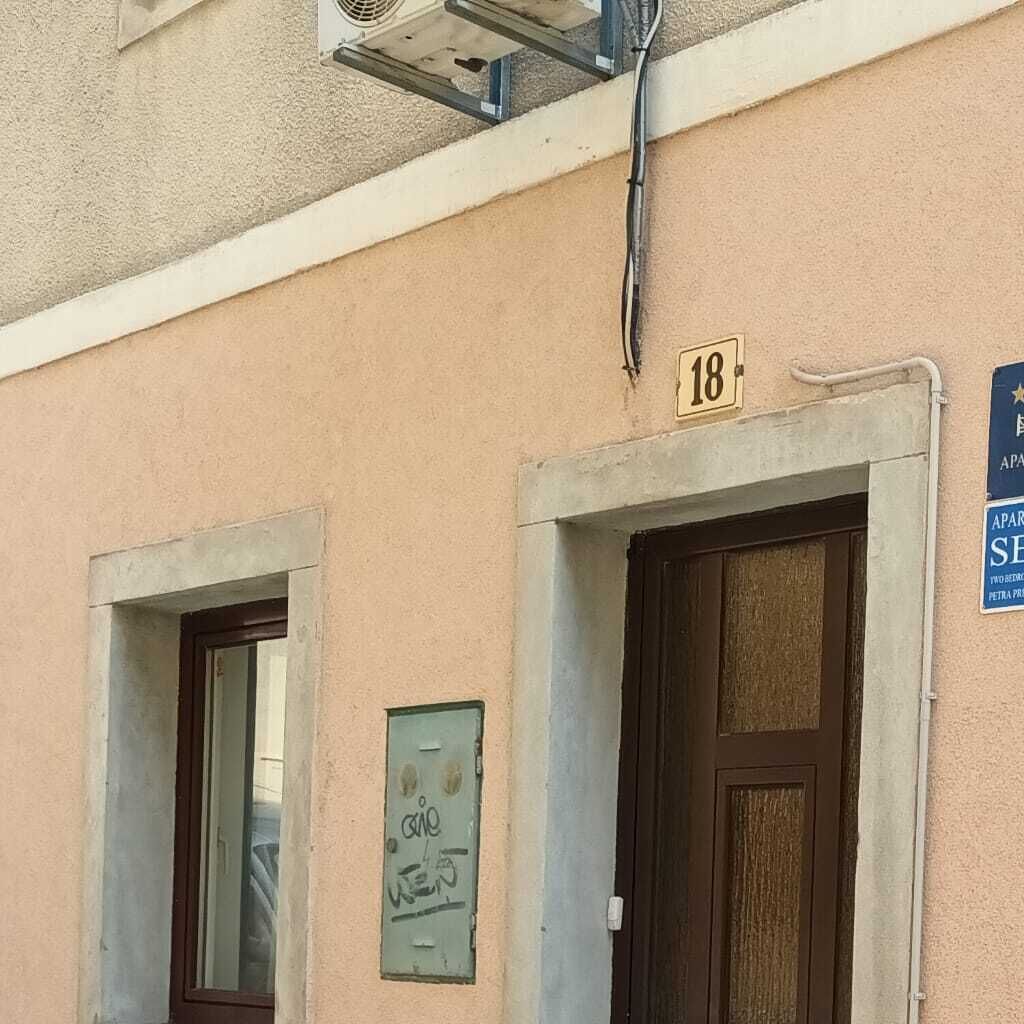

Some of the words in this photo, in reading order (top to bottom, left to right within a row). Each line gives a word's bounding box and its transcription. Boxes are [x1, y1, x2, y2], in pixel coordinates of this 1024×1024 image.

[691, 351, 724, 406] 18
[990, 575, 1004, 585] TWO
[988, 590, 1012, 601] PETRA
